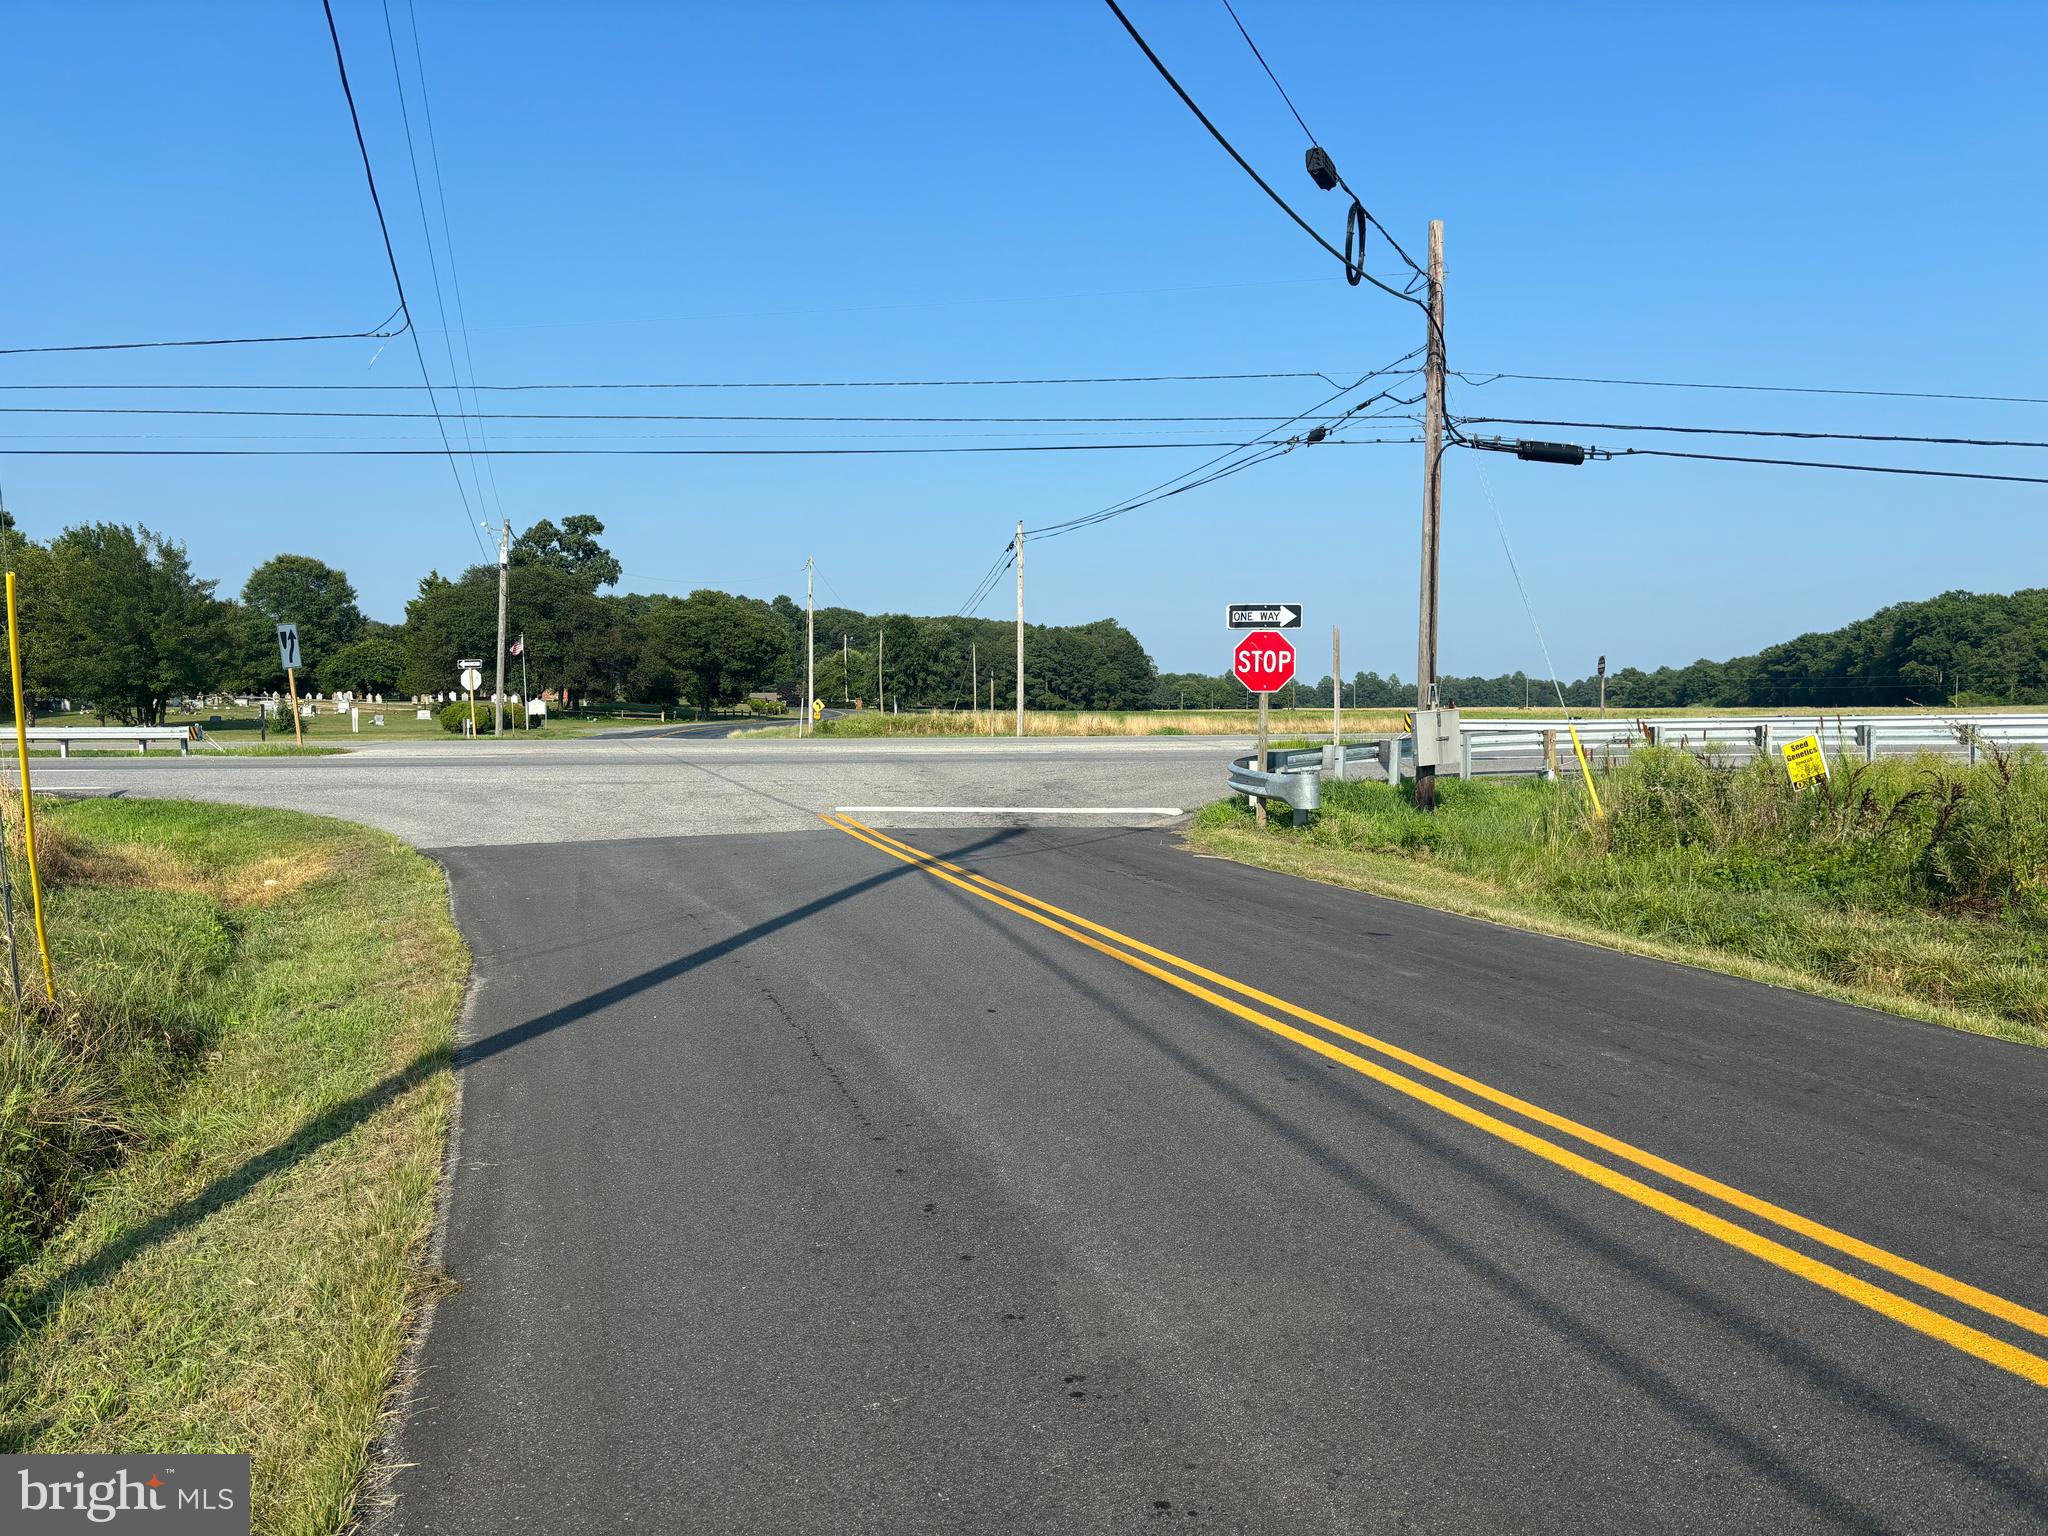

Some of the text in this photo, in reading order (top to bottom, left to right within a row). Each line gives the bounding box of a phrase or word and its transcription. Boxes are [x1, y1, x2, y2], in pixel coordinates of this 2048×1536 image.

[1233, 612, 1280, 621] ONE WAY
[1238, 650, 1291, 673] STOP
[1790, 740, 1809, 752] Seed
[1786, 747, 1818, 762] Genetics
